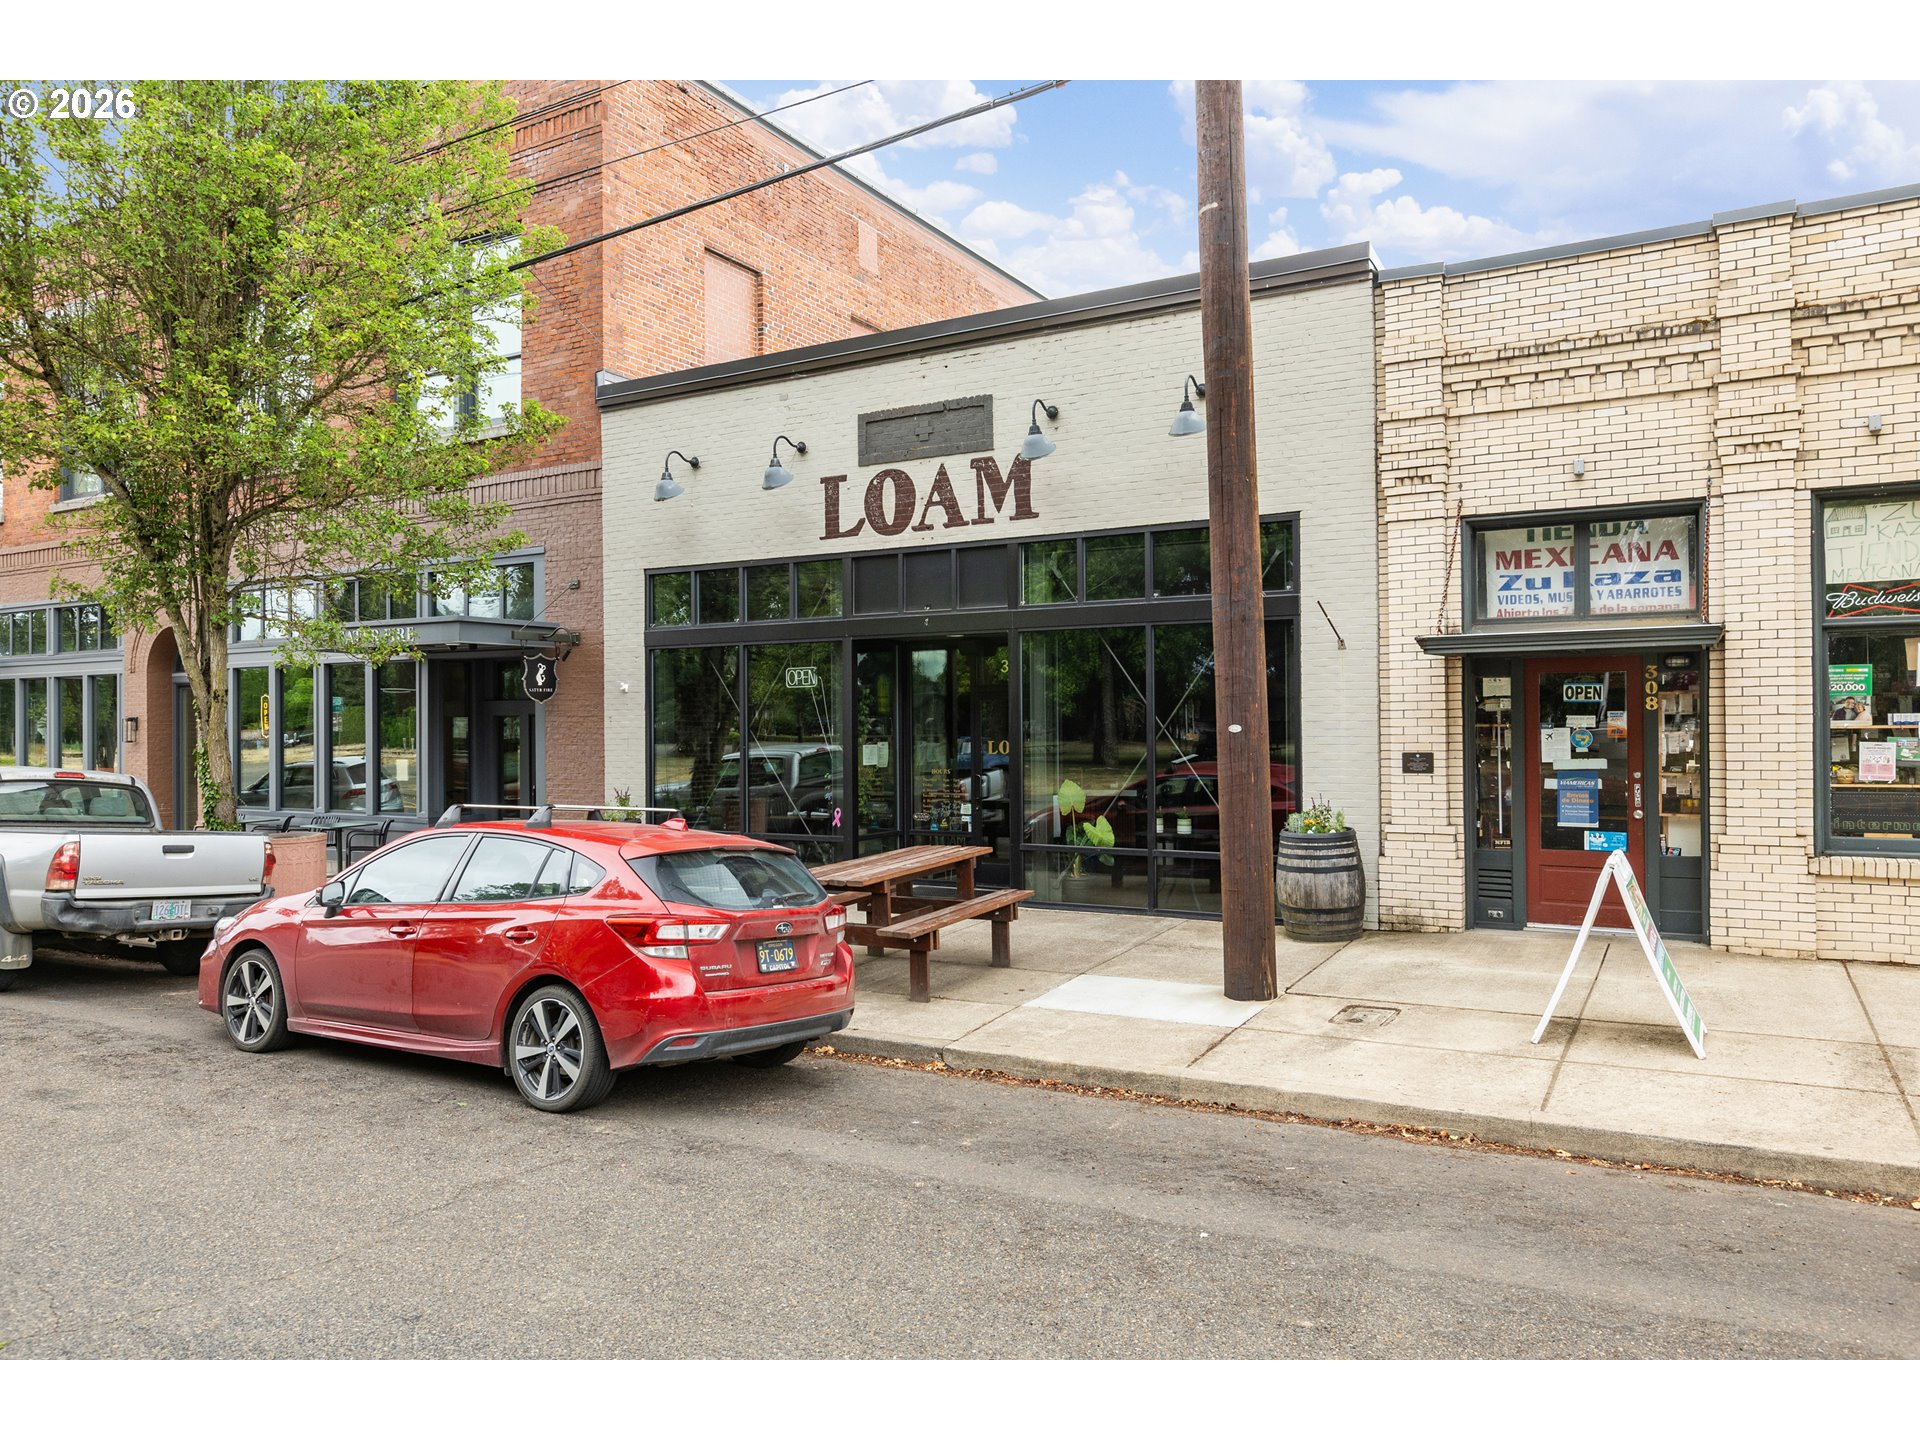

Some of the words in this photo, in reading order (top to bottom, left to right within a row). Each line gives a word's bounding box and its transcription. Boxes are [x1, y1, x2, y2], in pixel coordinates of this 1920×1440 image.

[819, 455, 1040, 541] LOAM
[1498, 574, 1552, 592] Zu
[1497, 593, 1543, 606] VIDEOS,
[1596, 590, 1604, 600] Y
[1607, 585, 1682, 600] ABARROTES
[788, 669, 816, 686] OPEN
[1565, 685, 1602, 700] OPEN
[1645, 665, 1658, 711] 308
[1829, 683, 1866, 692] 20,000
[759, 947, 794, 963] 9T-0679
